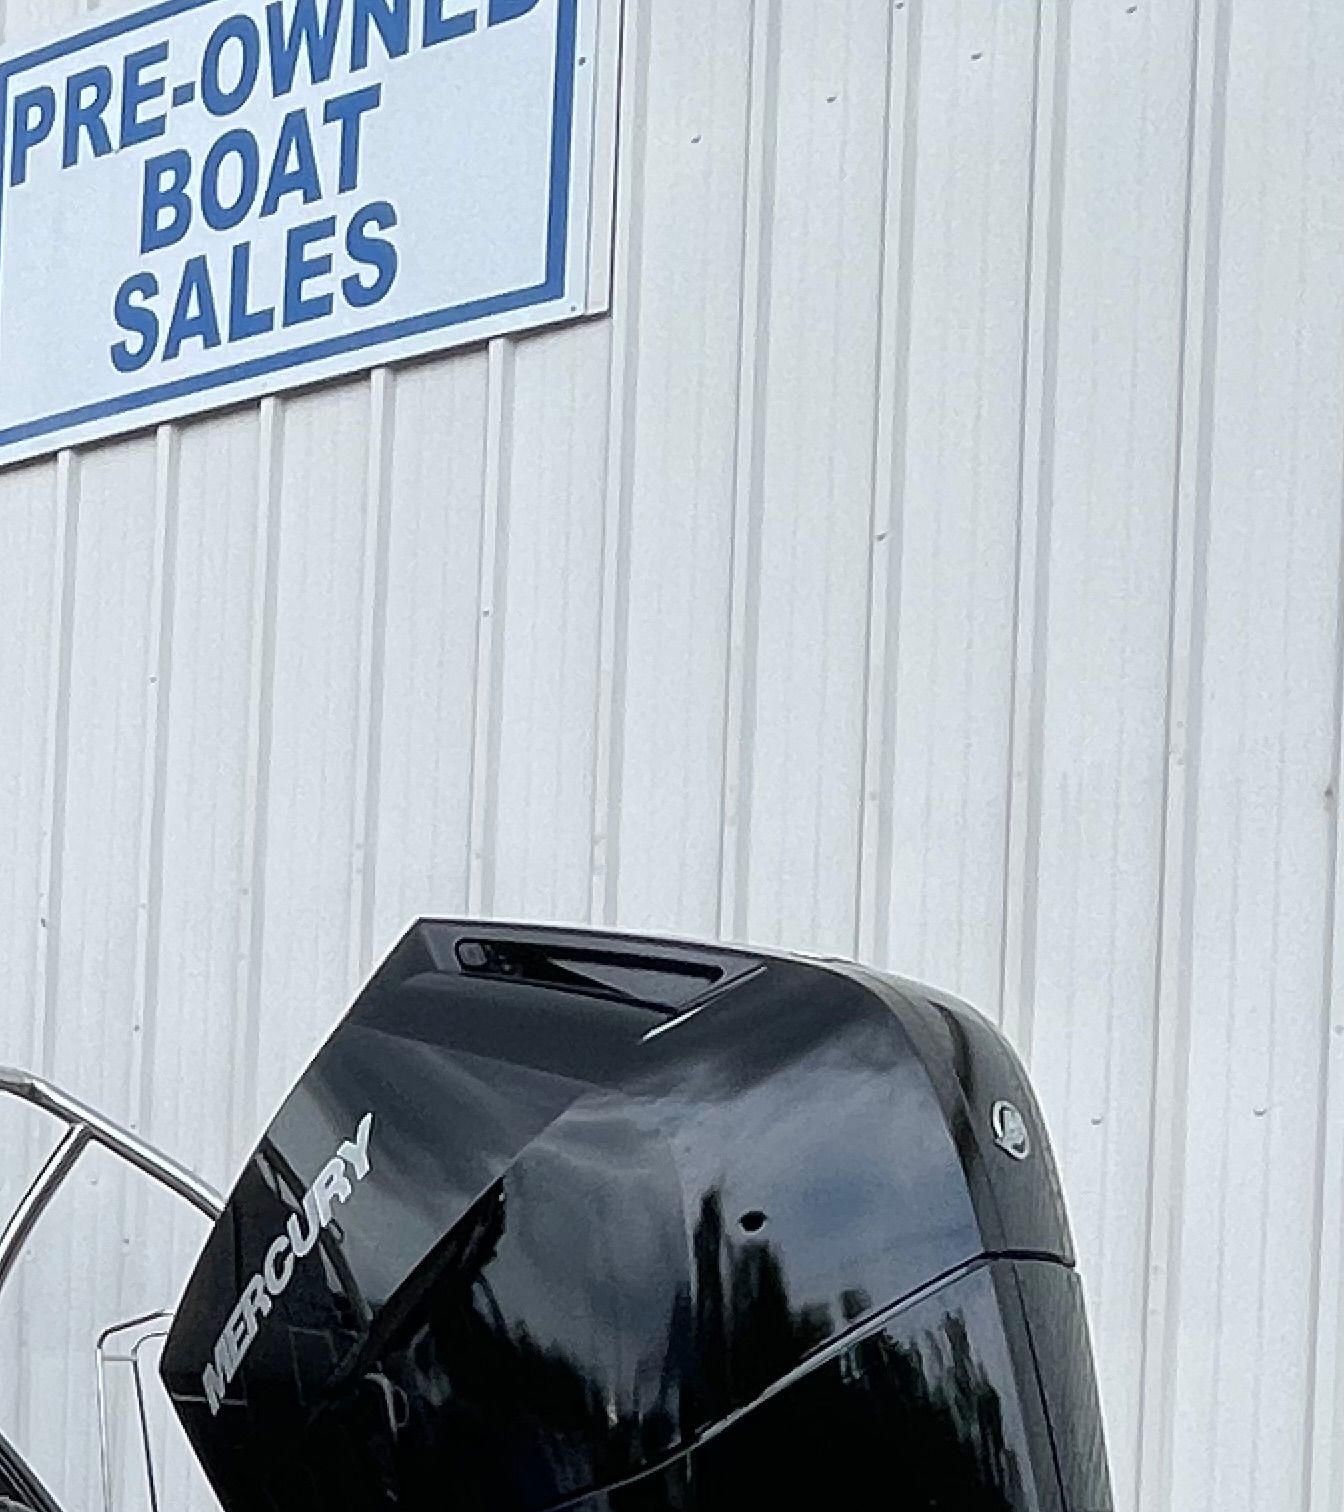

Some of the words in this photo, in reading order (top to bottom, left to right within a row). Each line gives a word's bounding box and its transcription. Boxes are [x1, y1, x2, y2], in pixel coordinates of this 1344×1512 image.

[12, 0, 539, 187] PRE-OWN
[140, 84, 381, 254] BOAT
[111, 201, 398, 373] SALES
[203, 1113, 373, 1415] MERCURY
